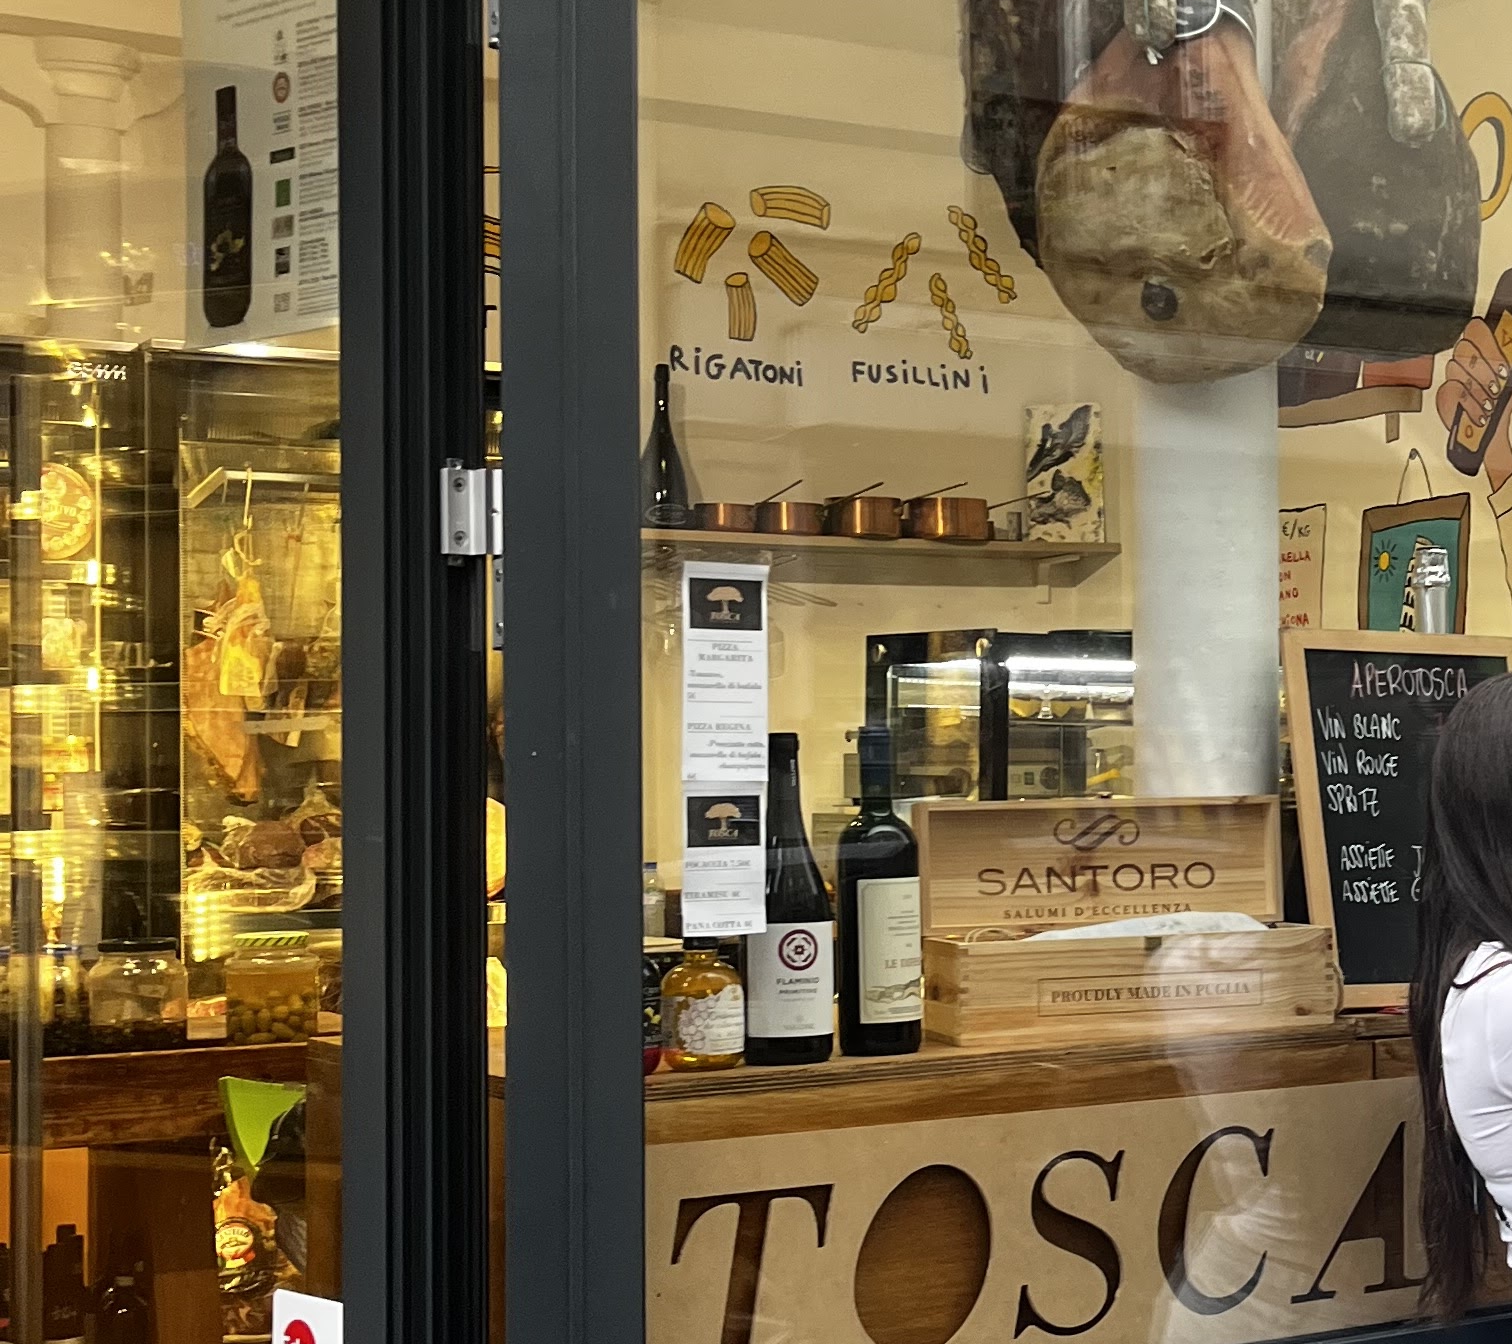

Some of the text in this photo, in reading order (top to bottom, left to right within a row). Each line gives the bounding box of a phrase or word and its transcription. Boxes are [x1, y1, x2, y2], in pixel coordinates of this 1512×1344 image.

[1350, 658, 1469, 700] APEROTOSCA
[1352, 712, 1402, 741] BLANC
[1356, 748, 1399, 777] ROUGE
[977, 861, 1216, 896] SANTORO
[1003, 902, 1193, 920] SALUMI D'ECCELLENZA
[1051, 981, 1250, 1004] PROUDLY MADE IN PUGLIA
